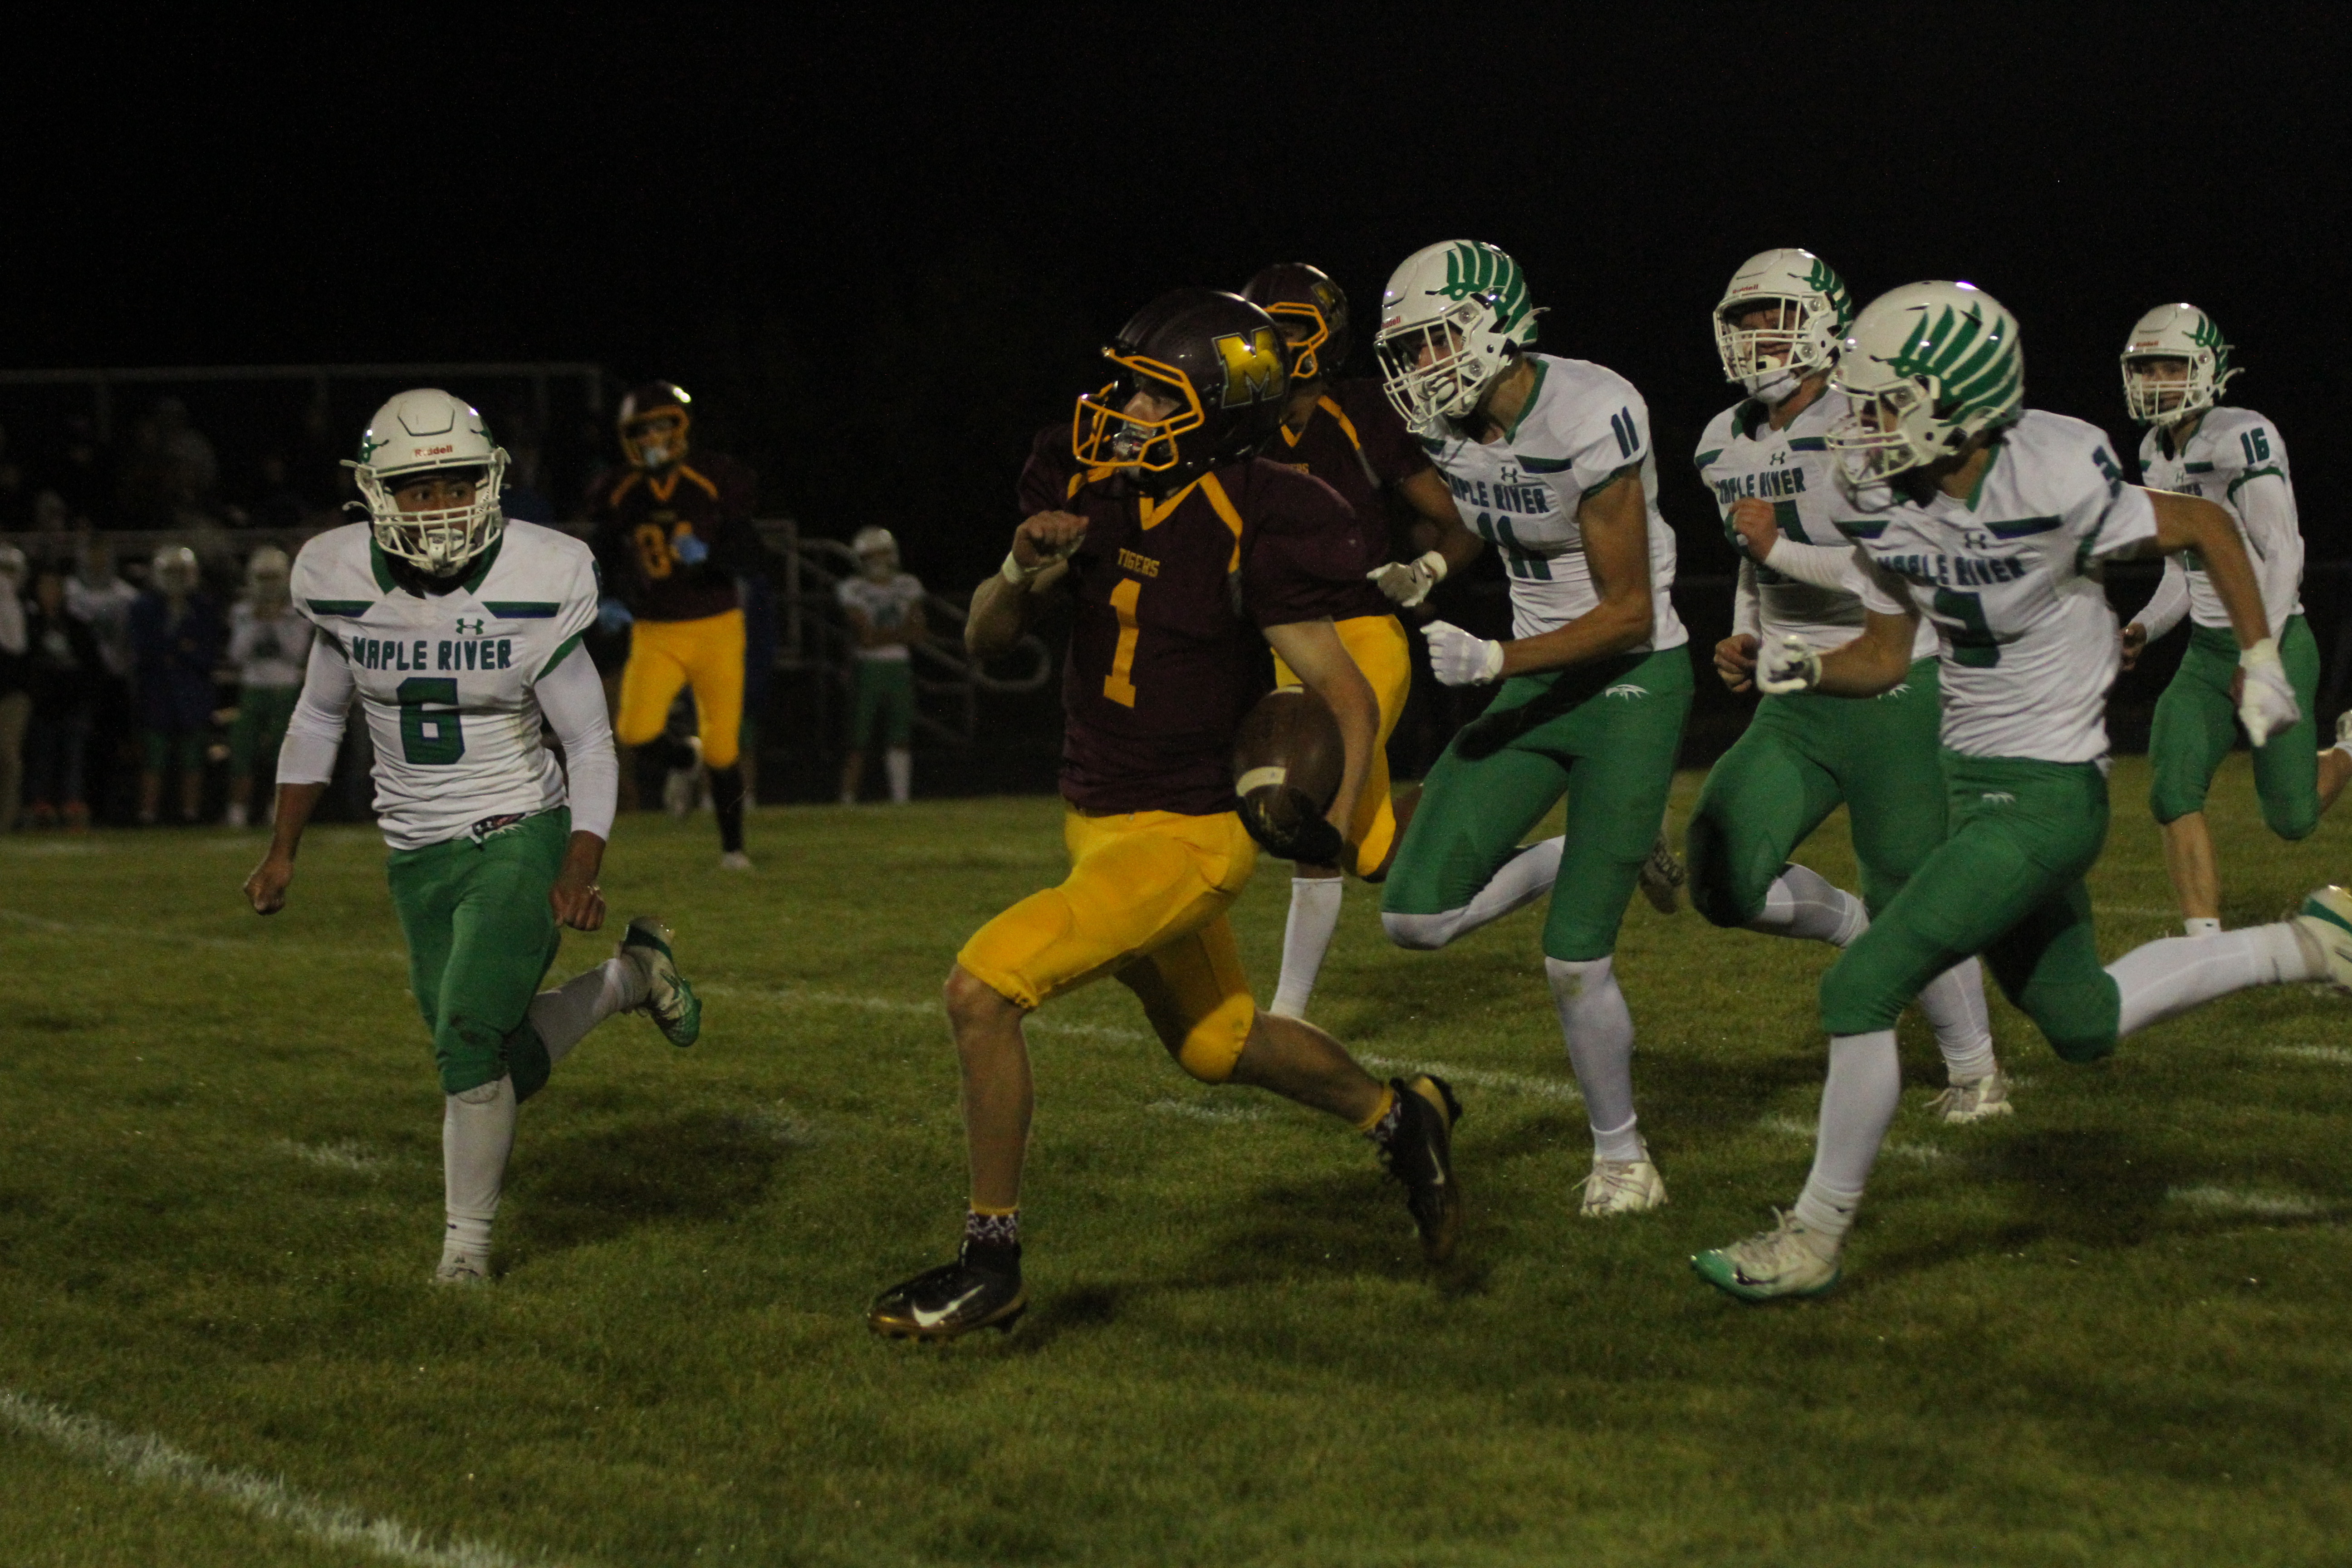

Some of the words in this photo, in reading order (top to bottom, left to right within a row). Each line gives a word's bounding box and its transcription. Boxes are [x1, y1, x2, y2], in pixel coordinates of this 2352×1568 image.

[1211, 325, 1284, 409] M
[414, 445, 453, 456] Rddell
[1611, 406, 1640, 460] 11
[2240, 427, 2270, 465] 16
[1493, 483, 1550, 514] RIVER
[1759, 467, 1806, 498] RIVER
[1117, 547, 1161, 578] TIGERS
[1477, 512, 1553, 581] 11
[353, 636, 427, 671] MAPLE
[438, 639, 511, 670] RIVER
[1103, 578, 1142, 708] 1
[396, 677, 466, 765] 6
